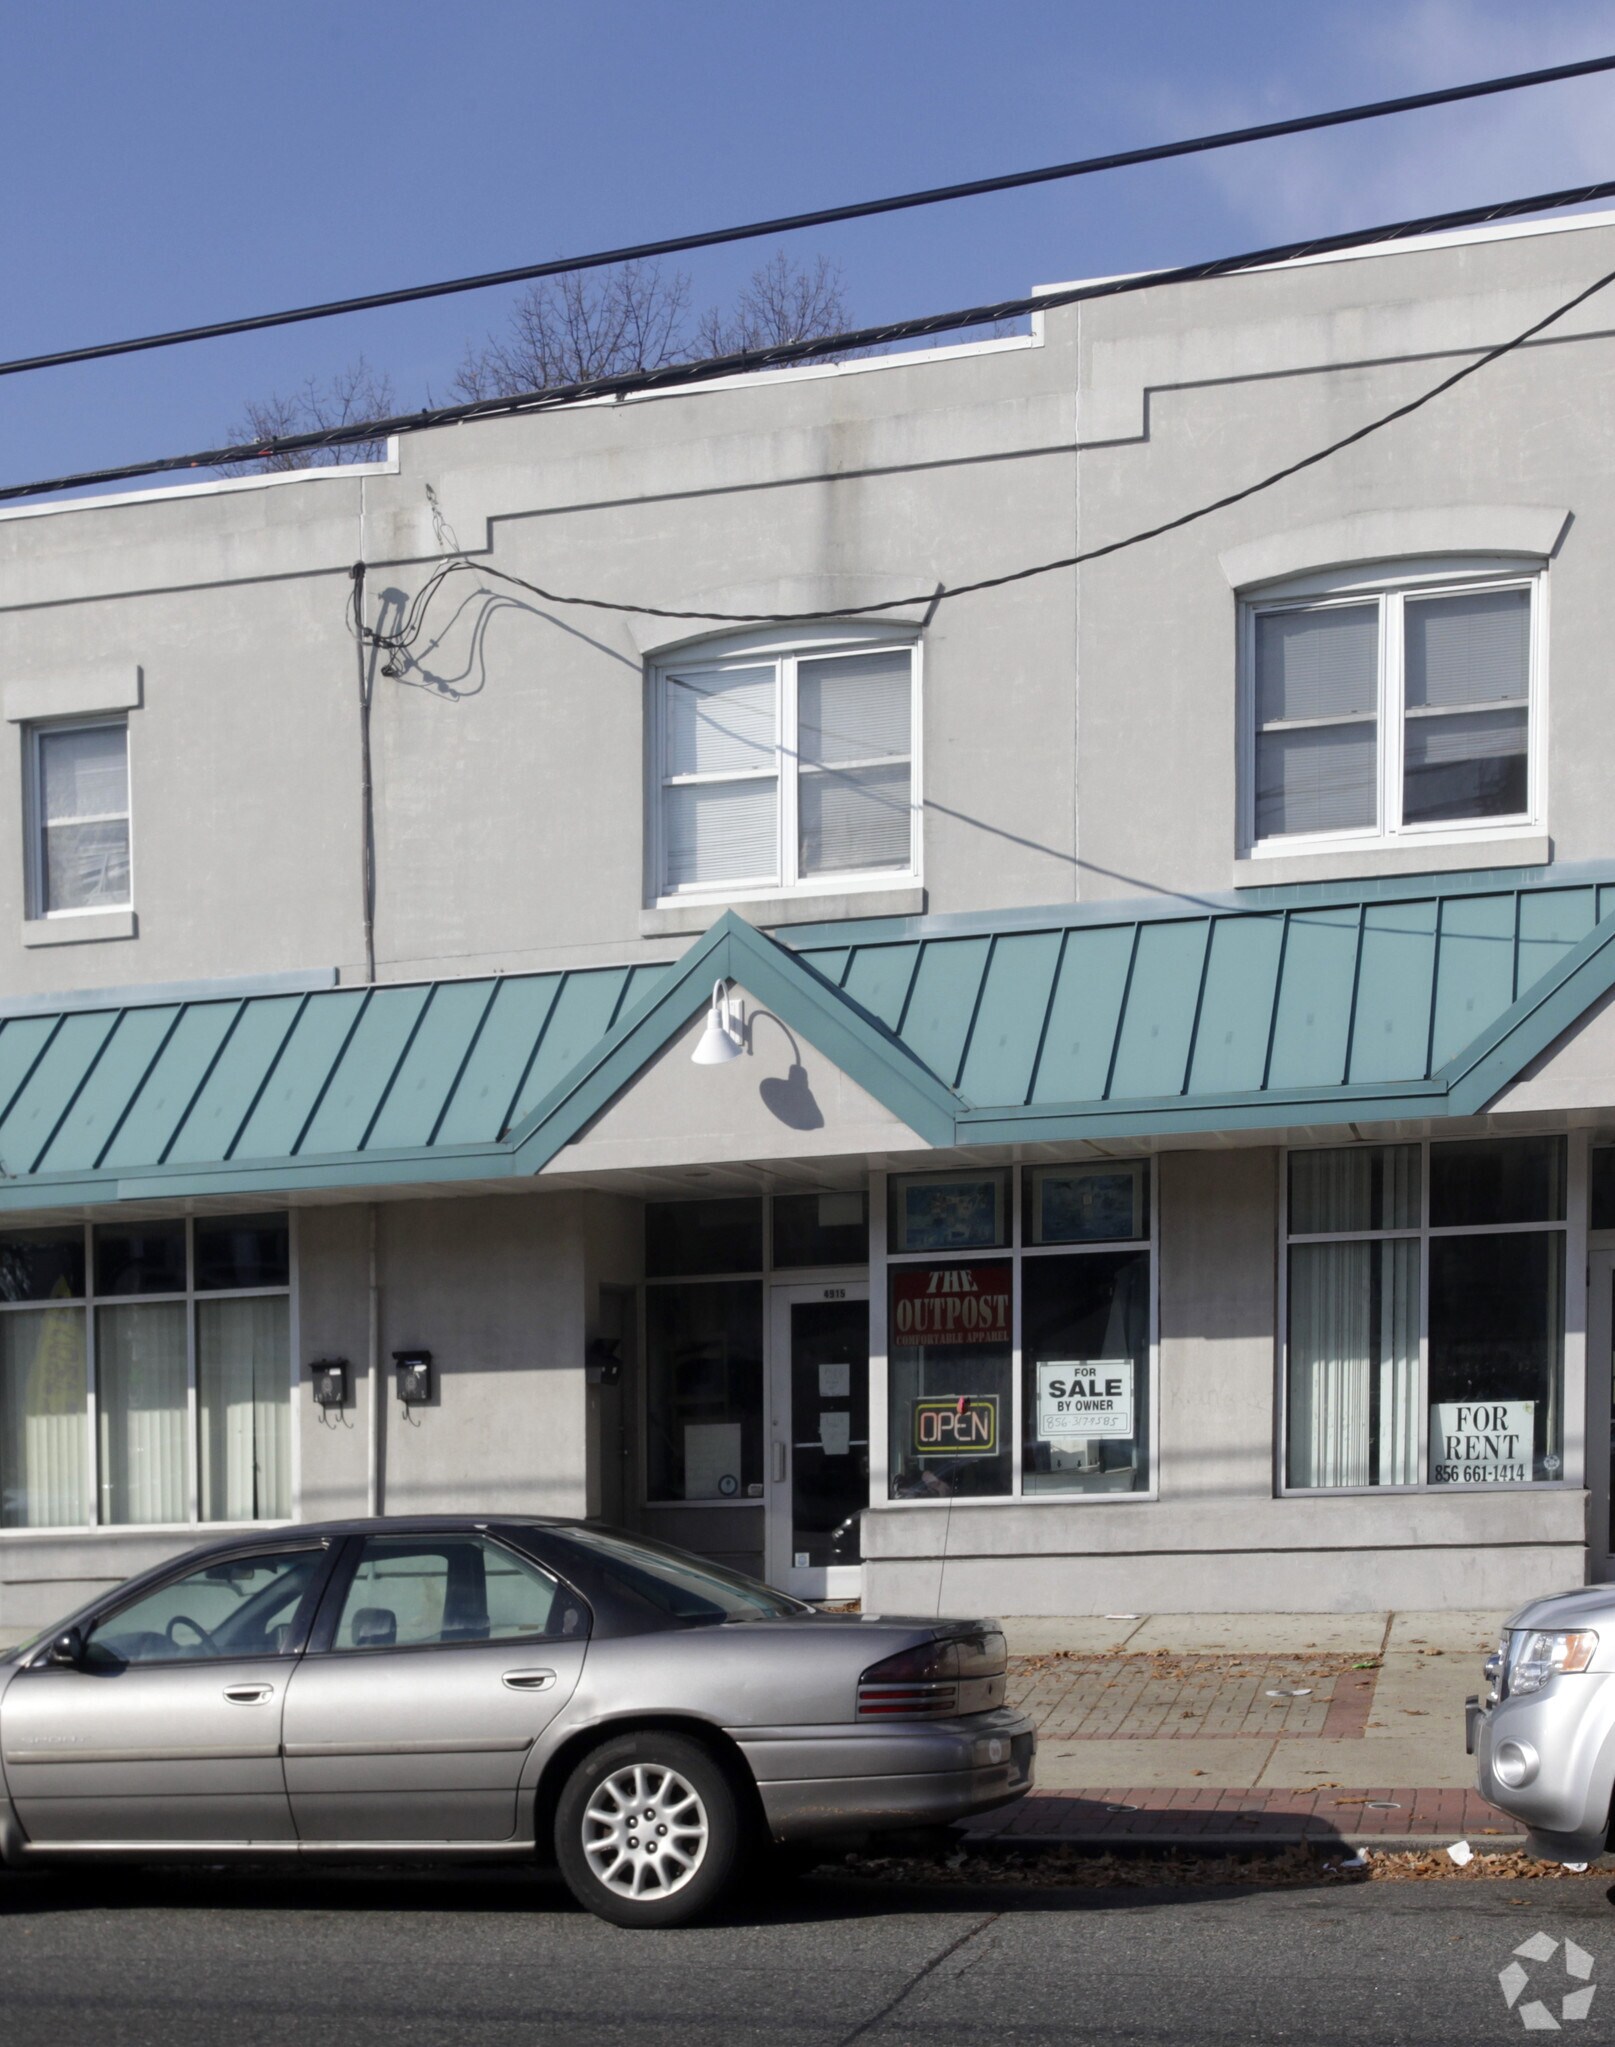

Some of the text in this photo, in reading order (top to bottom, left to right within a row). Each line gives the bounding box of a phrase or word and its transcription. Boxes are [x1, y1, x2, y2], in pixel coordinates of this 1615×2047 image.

[926, 1270, 978, 1293] THE
[824, 1289, 846, 1298] 4915
[896, 1294, 1008, 1332] OUTPOST
[896, 1330, 1009, 1346] COMFORTABLE APPAREL
[1074, 1368, 1096, 1377] FOR
[1048, 1379, 1122, 1398] SALE
[1057, 1399, 1113, 1412] BY OWNER
[920, 1411, 988, 1441] OPEN
[1455, 1406, 1509, 1432] FOR
[1444, 1434, 1519, 1461] RENT
[1435, 1464, 1525, 1482] 856 661-1414
